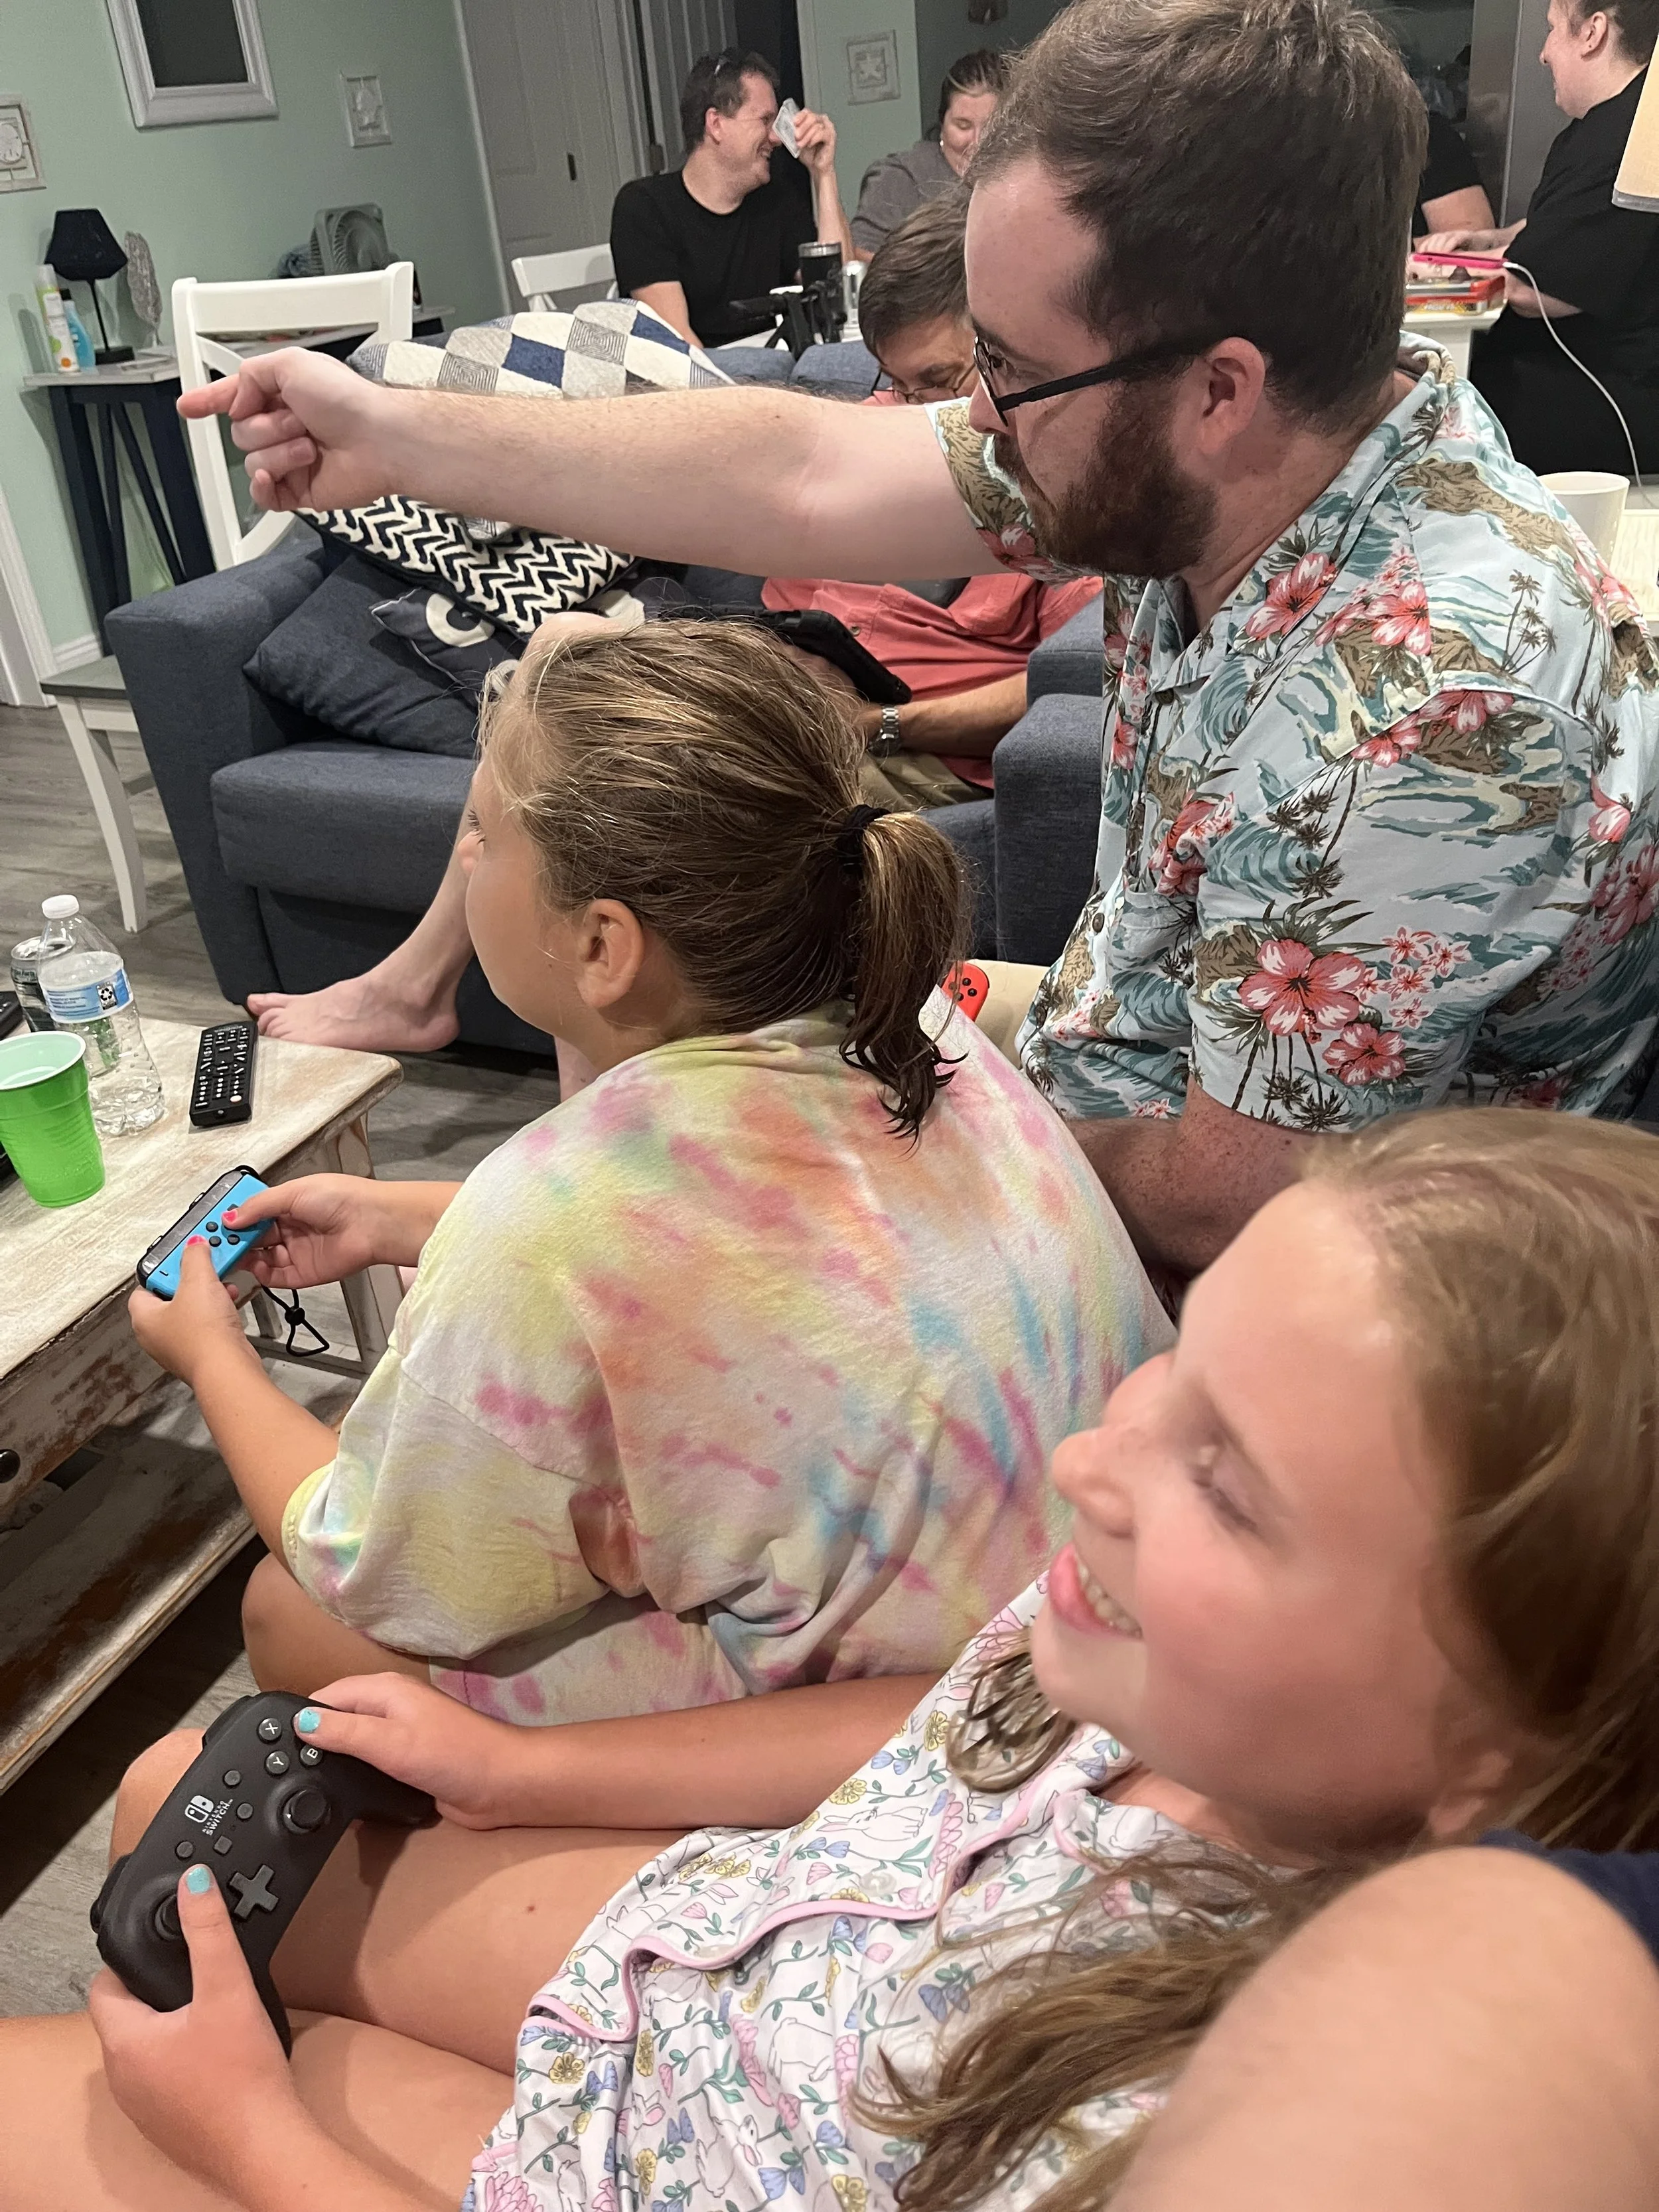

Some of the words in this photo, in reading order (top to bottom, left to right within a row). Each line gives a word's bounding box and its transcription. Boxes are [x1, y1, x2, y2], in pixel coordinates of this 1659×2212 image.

[265, 1722, 279, 1735] X
[306, 1747, 319, 1759] B
[272, 1756, 285, 1766] Y
[206, 1802, 231, 1836] SWITCH
